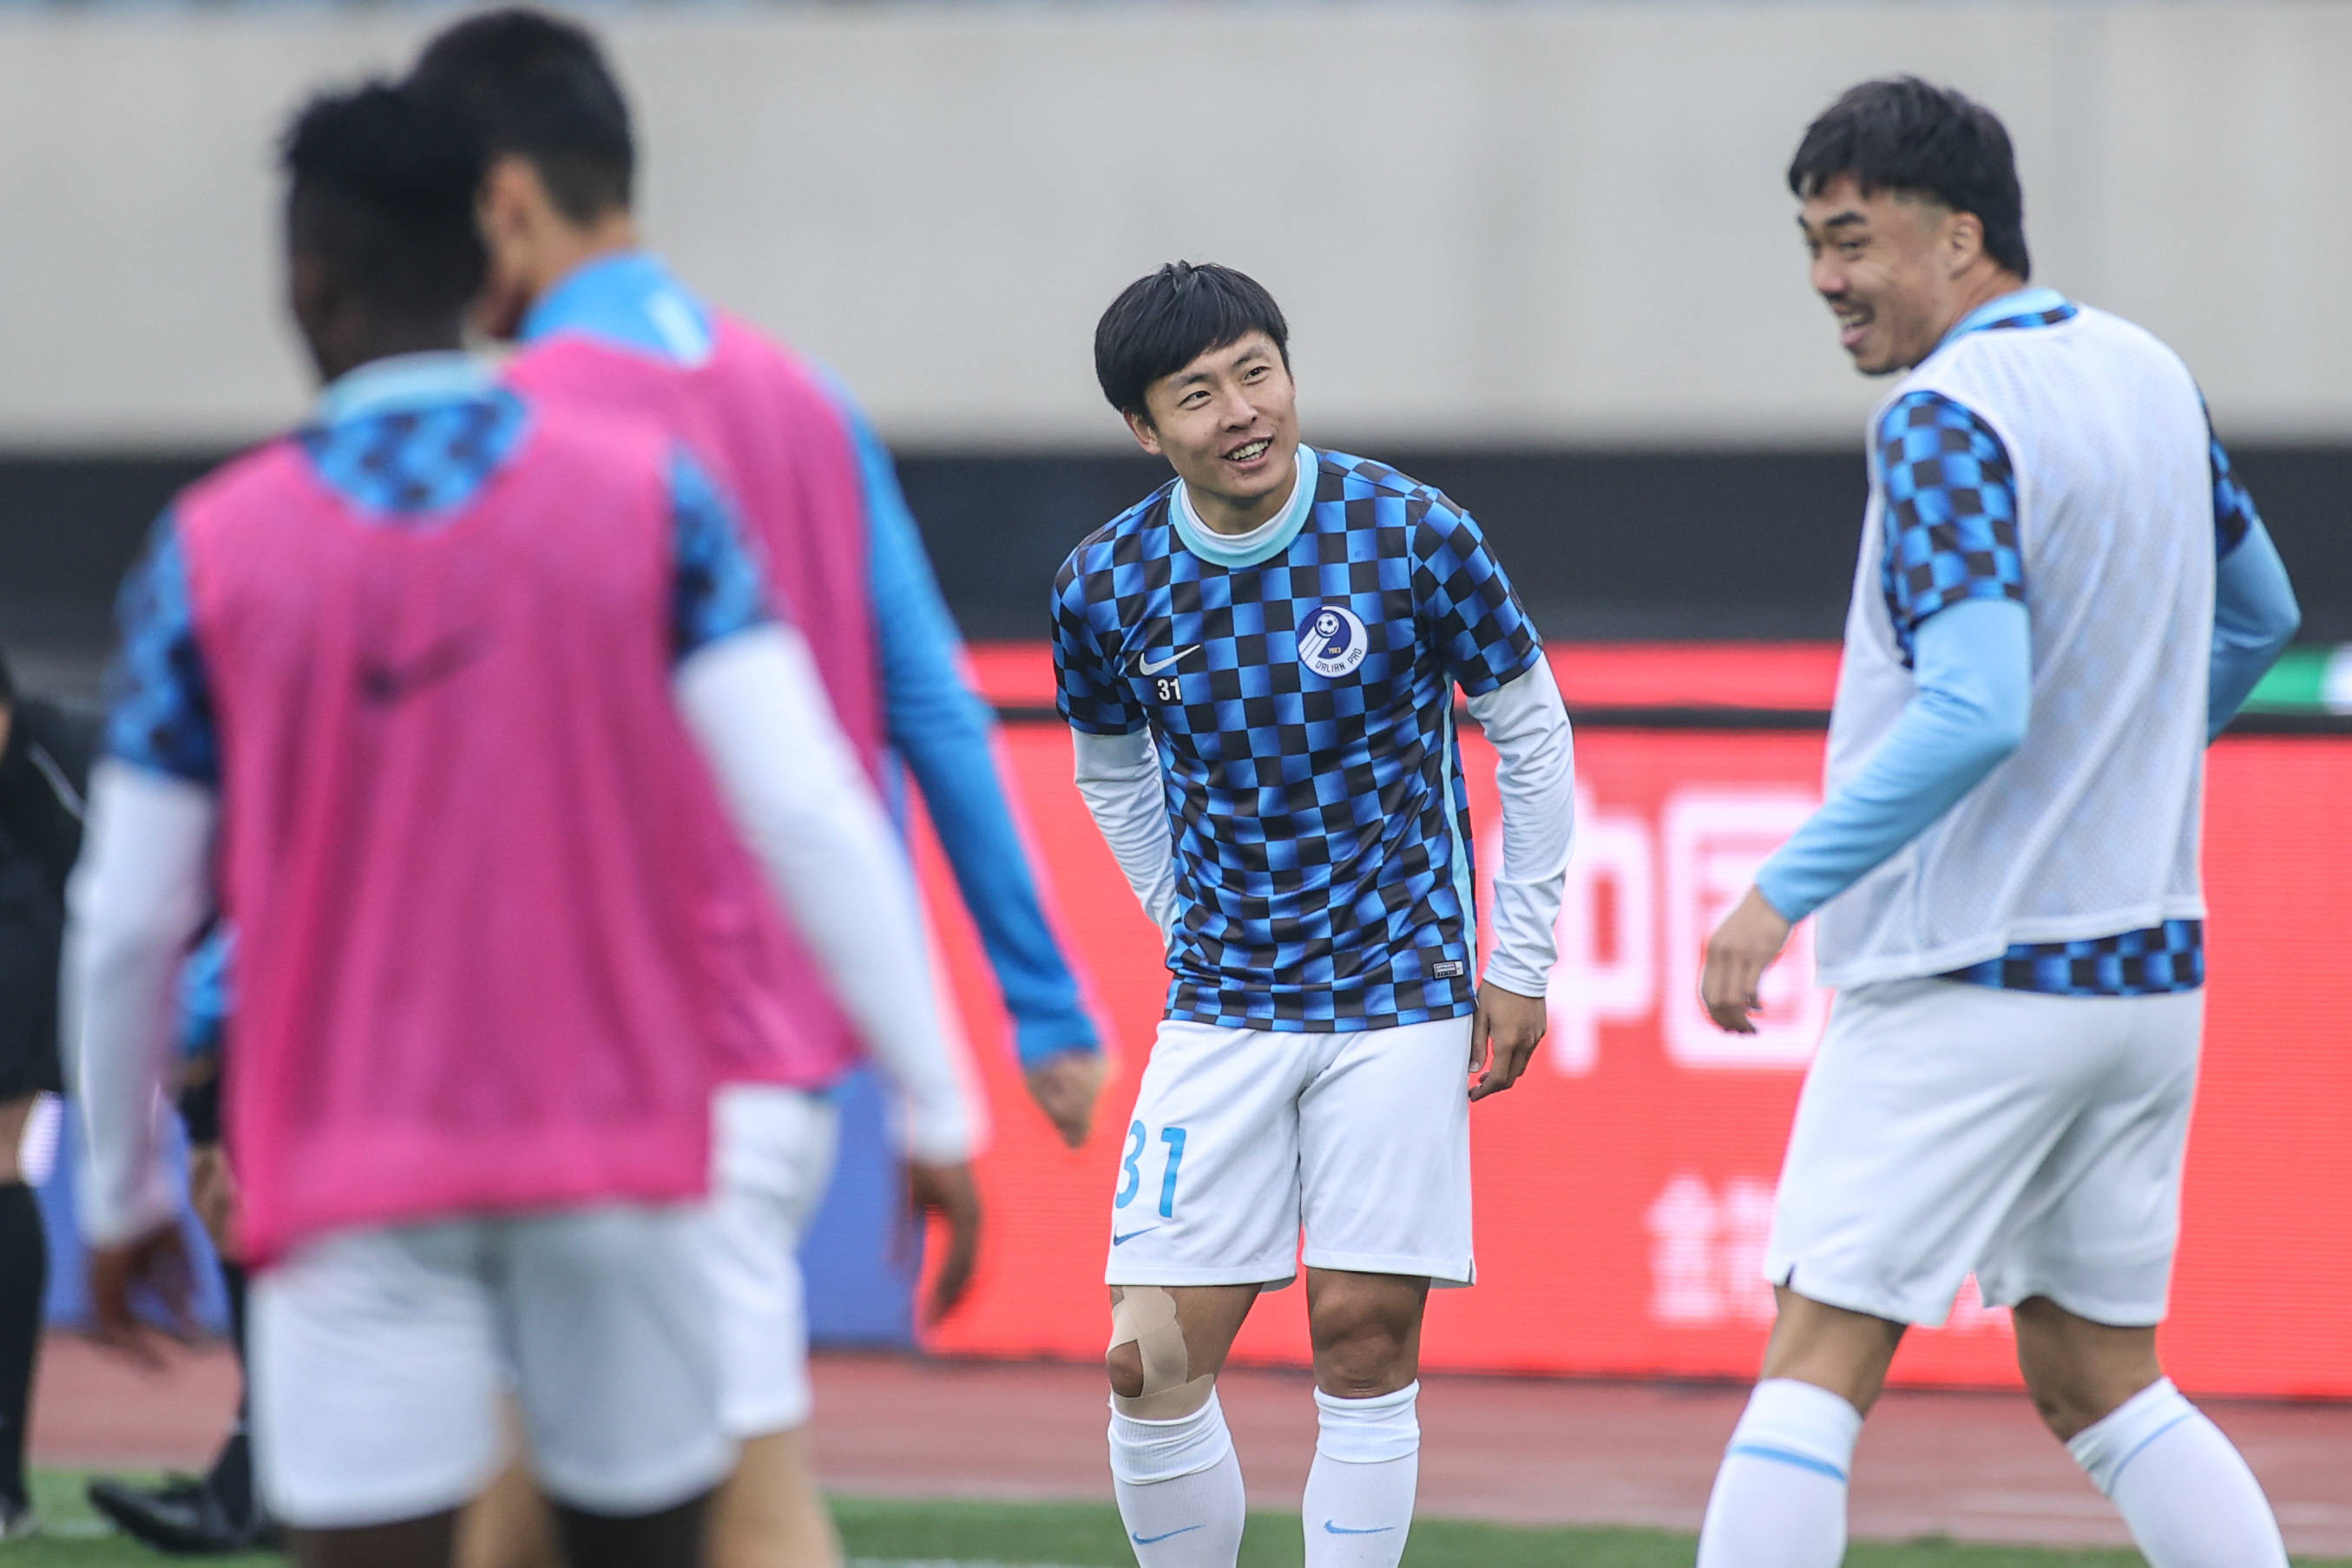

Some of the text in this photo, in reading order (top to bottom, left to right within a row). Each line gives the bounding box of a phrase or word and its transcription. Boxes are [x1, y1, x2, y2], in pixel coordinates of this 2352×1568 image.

[1315, 660, 1346, 673] DALIAN
[1157, 678, 1181, 701] 31
[1115, 1119, 1186, 1218] 31
